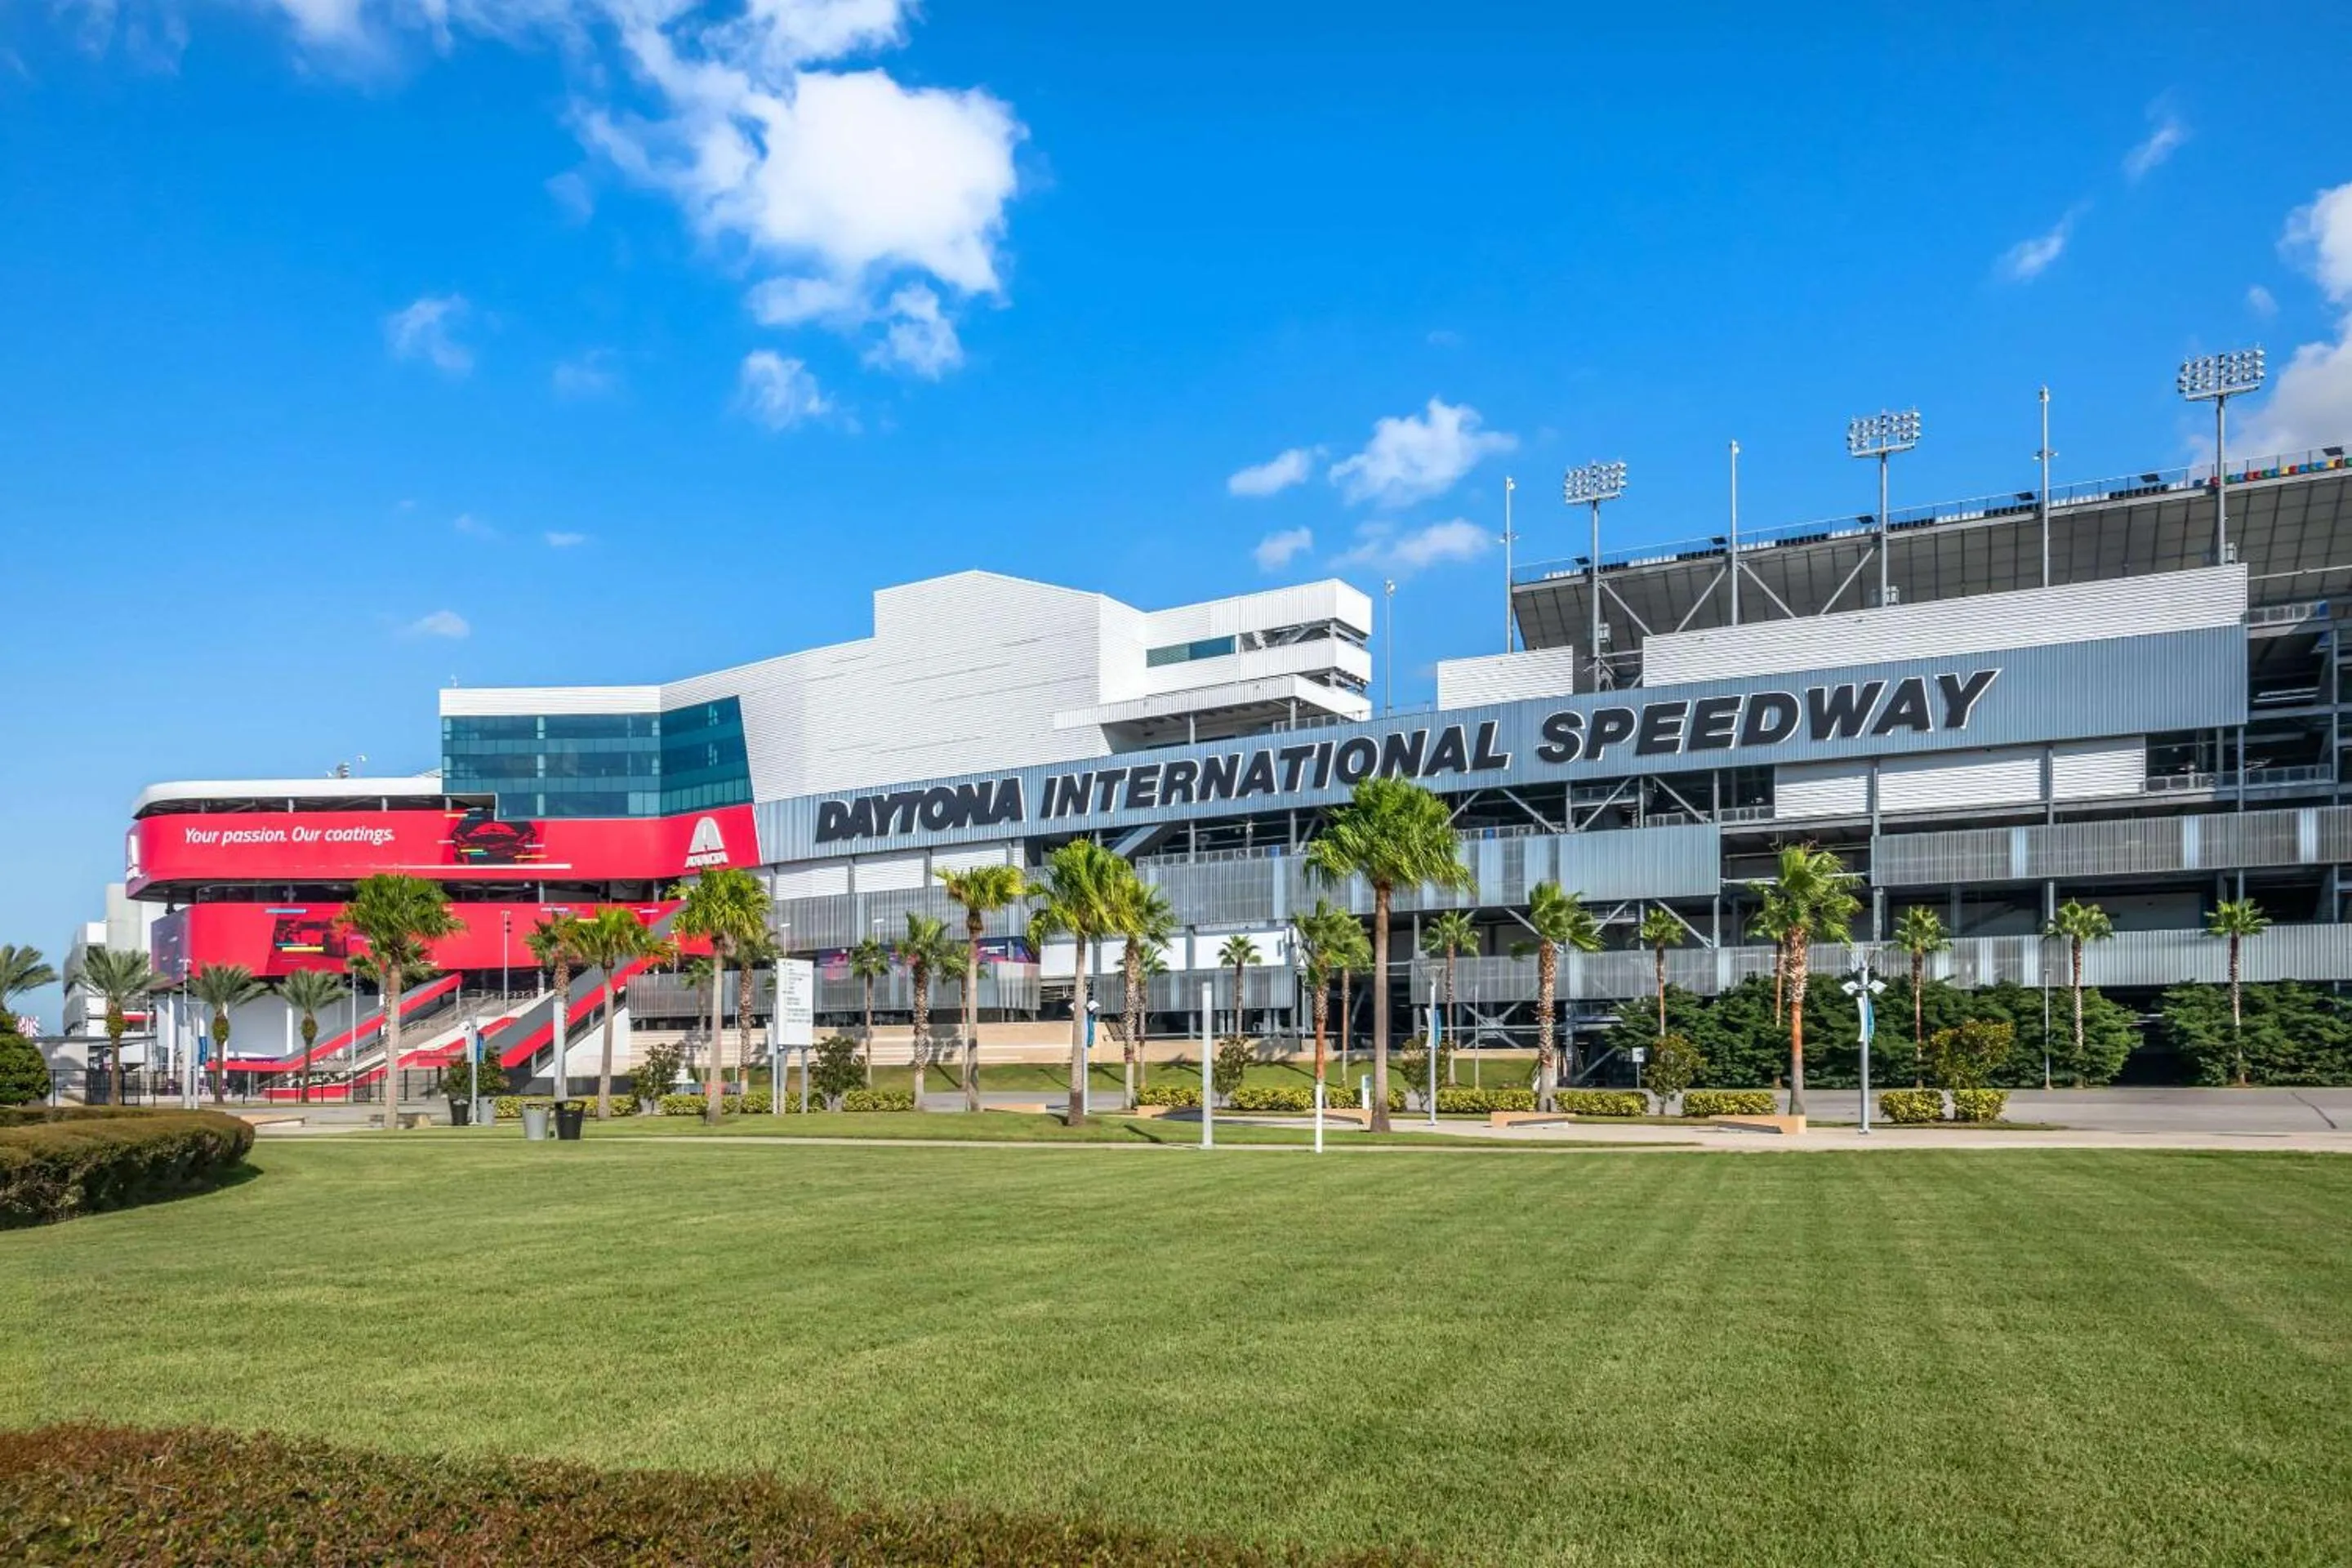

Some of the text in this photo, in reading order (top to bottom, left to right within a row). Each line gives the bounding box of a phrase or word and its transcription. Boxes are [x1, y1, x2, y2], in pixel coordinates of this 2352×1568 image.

[815, 668, 2002, 843] DAYTONA INTERNATIONAL SPEEDWAY
[185, 825, 395, 847] Your passion. Our coatings.
